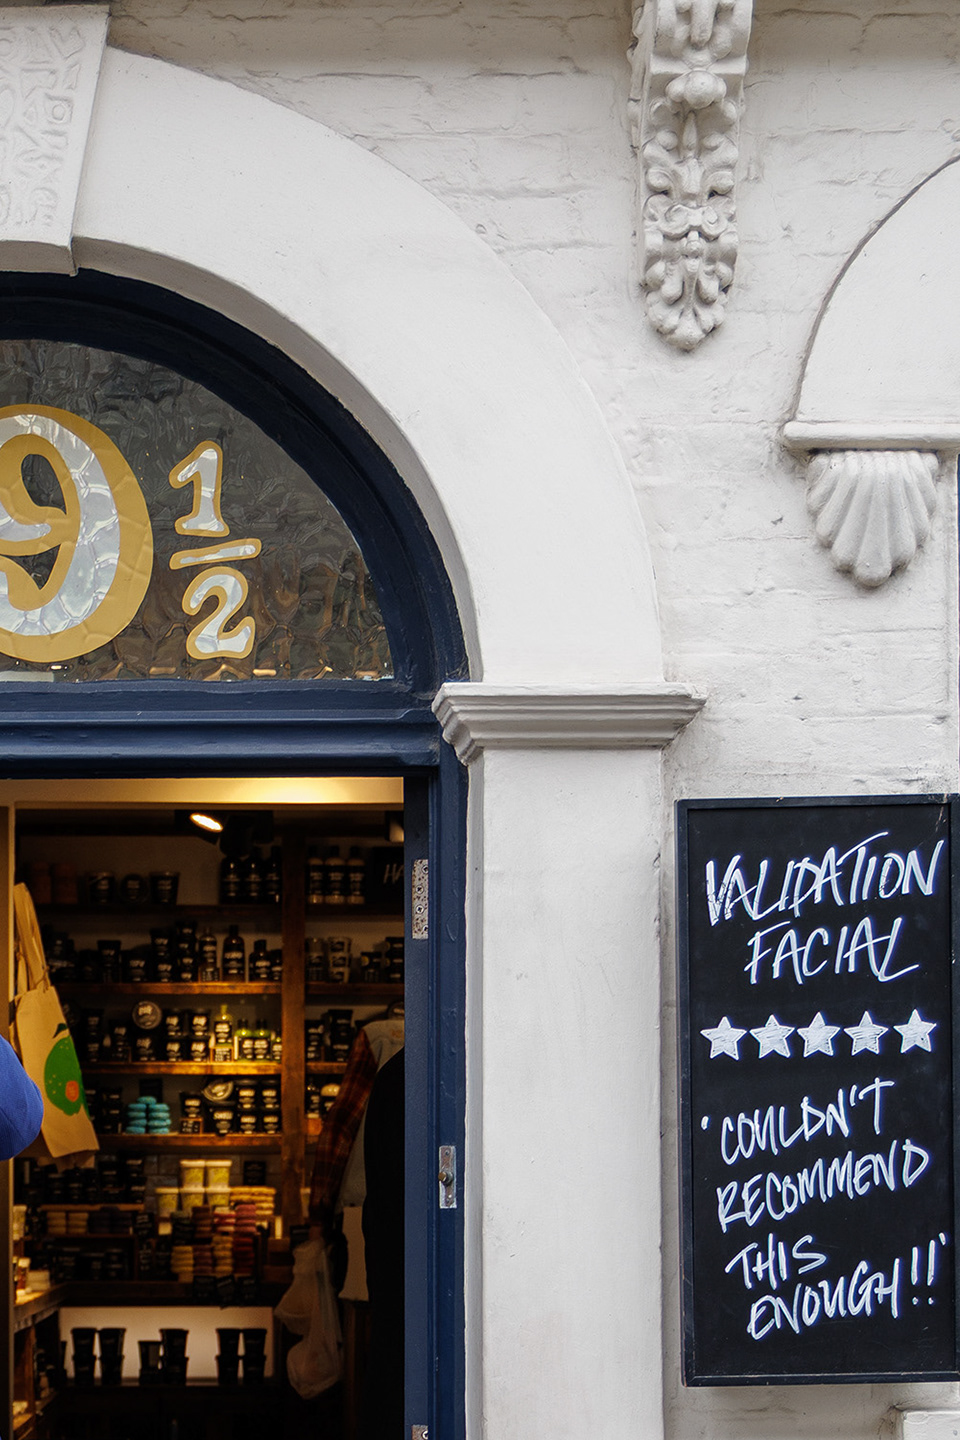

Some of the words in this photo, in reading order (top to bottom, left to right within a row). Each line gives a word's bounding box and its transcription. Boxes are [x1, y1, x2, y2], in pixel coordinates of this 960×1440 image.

[705, 831, 945, 927] VALIDATION
[743, 916, 920, 985] FACIAL
[716, 1138, 930, 1234] RECOMMEND
[724, 1232, 828, 1291] THIS
